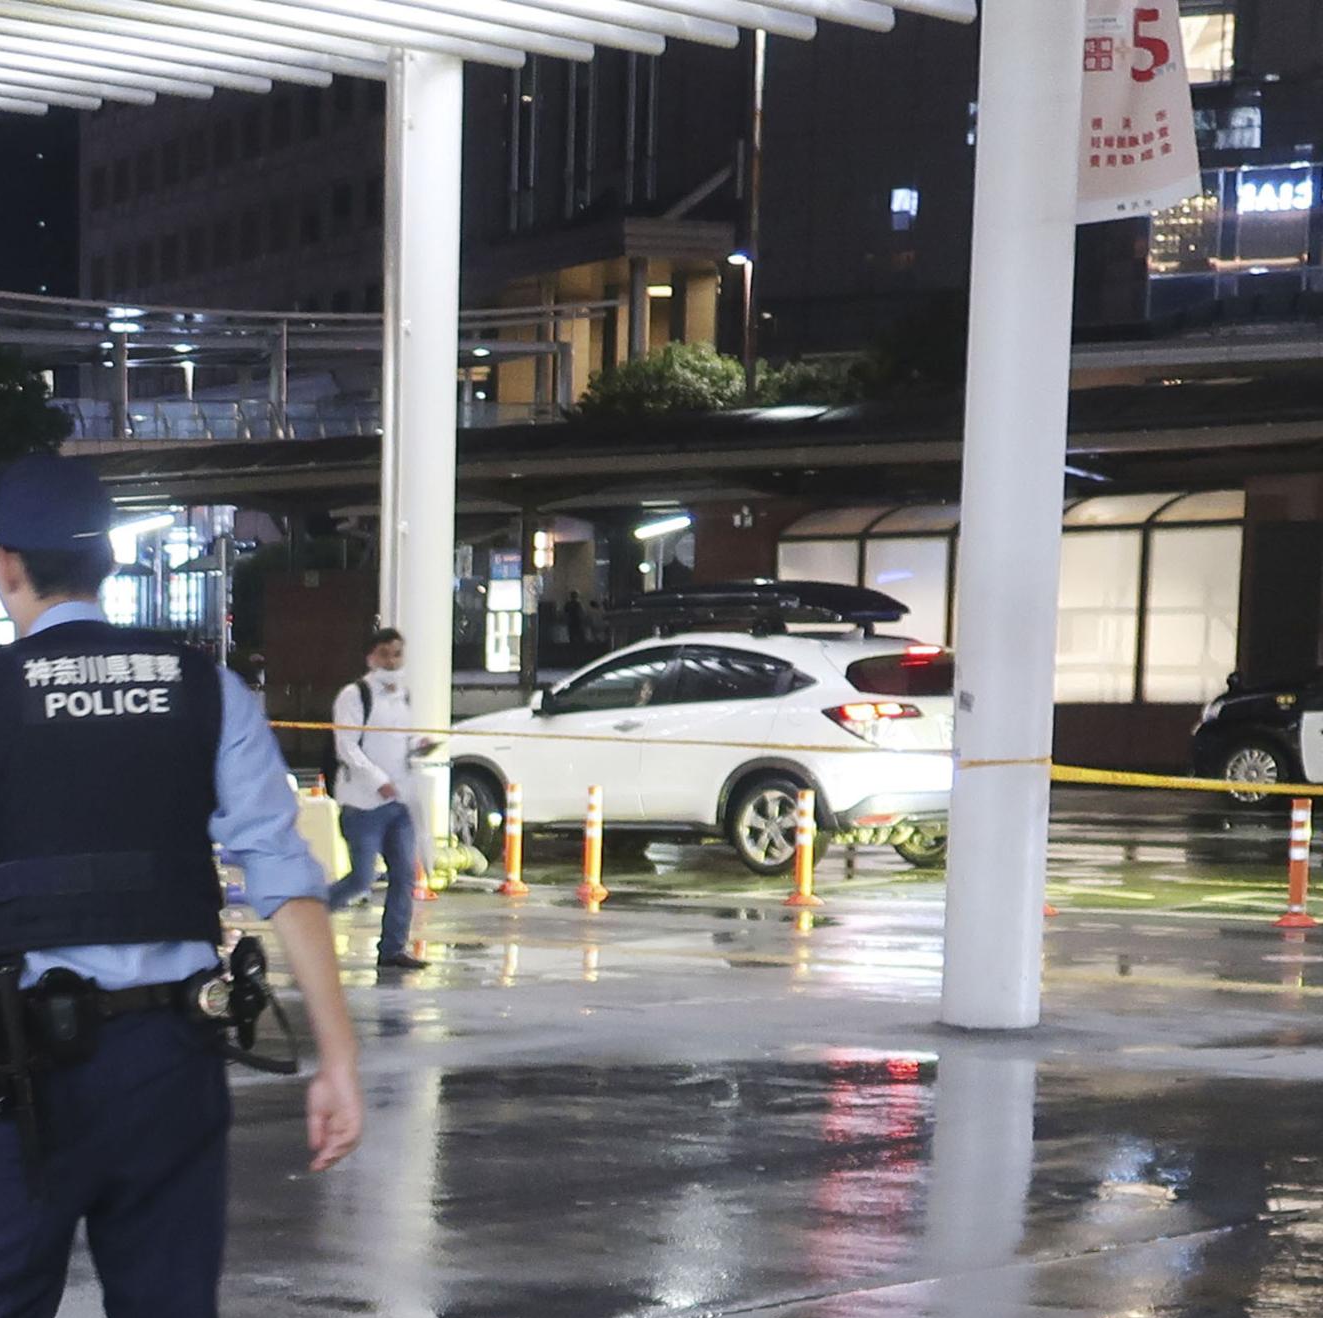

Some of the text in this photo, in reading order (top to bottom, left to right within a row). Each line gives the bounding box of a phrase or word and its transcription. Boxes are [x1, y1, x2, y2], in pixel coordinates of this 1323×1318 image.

[1131, 8, 1169, 82] 5
[22, 653, 182, 688] 神奈川県警察
[44, 687, 171, 719] POLICE
